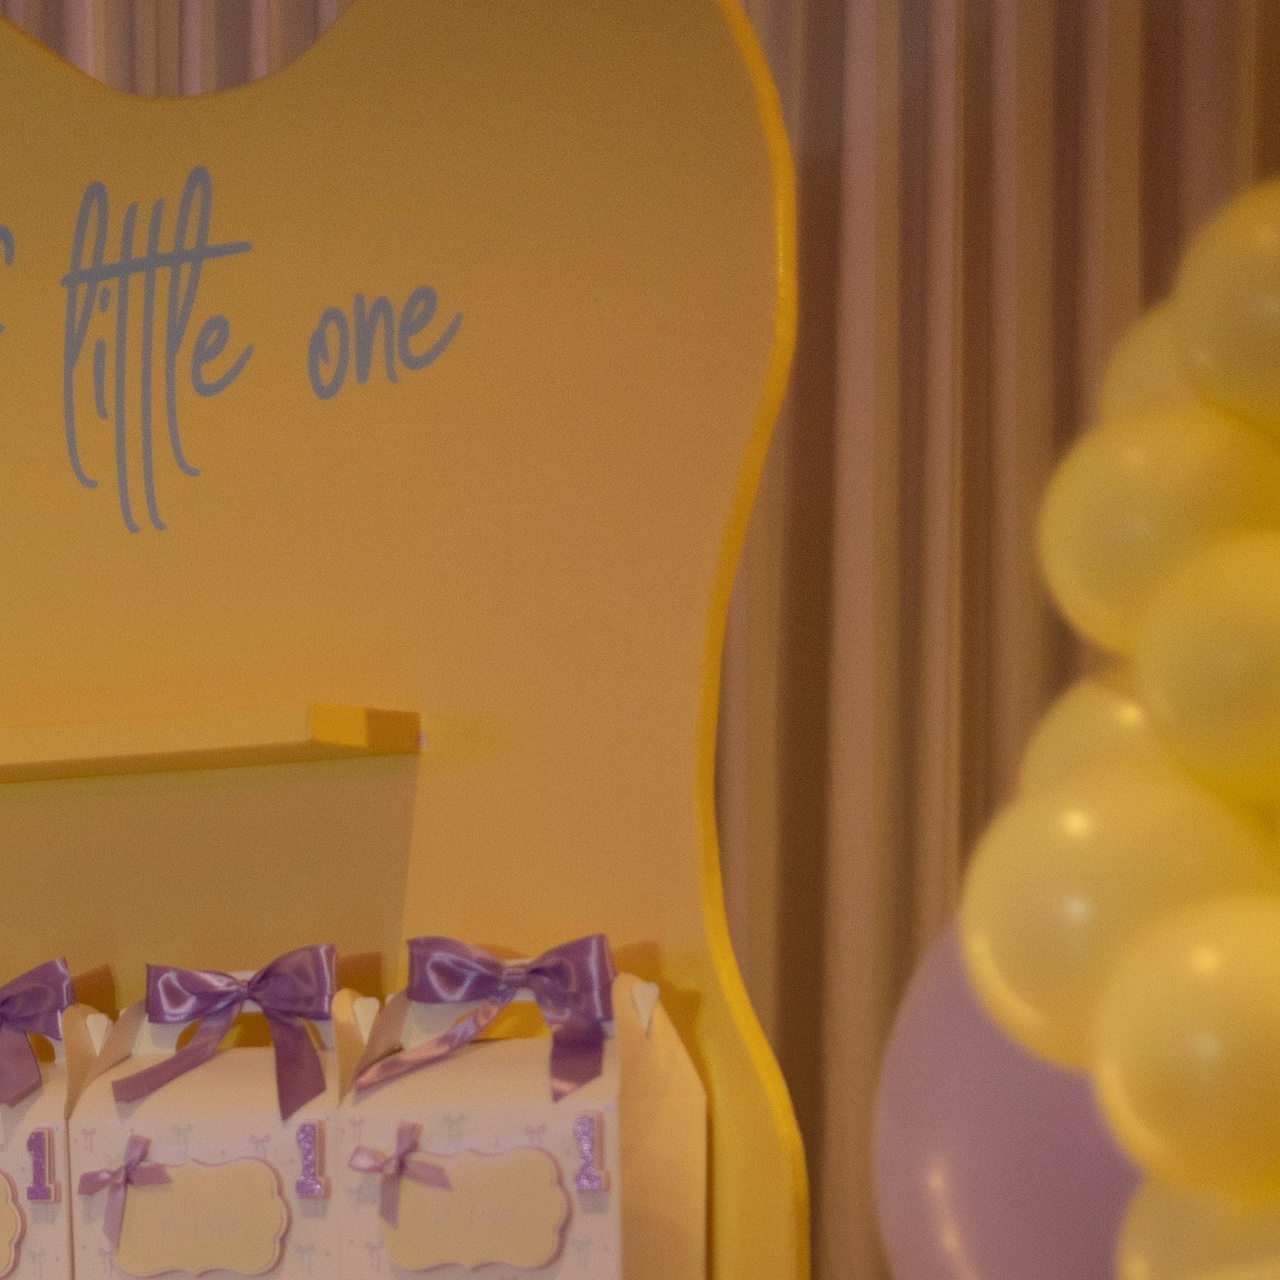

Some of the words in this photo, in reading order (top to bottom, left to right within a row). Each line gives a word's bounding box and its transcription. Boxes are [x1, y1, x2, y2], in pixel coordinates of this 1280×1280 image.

[61, 165, 255, 534] little
[307, 284, 464, 401] one
[26, 1126, 61, 1202] 1
[295, 1119, 331, 1199] 1
[572, 1112, 610, 1194] 1
